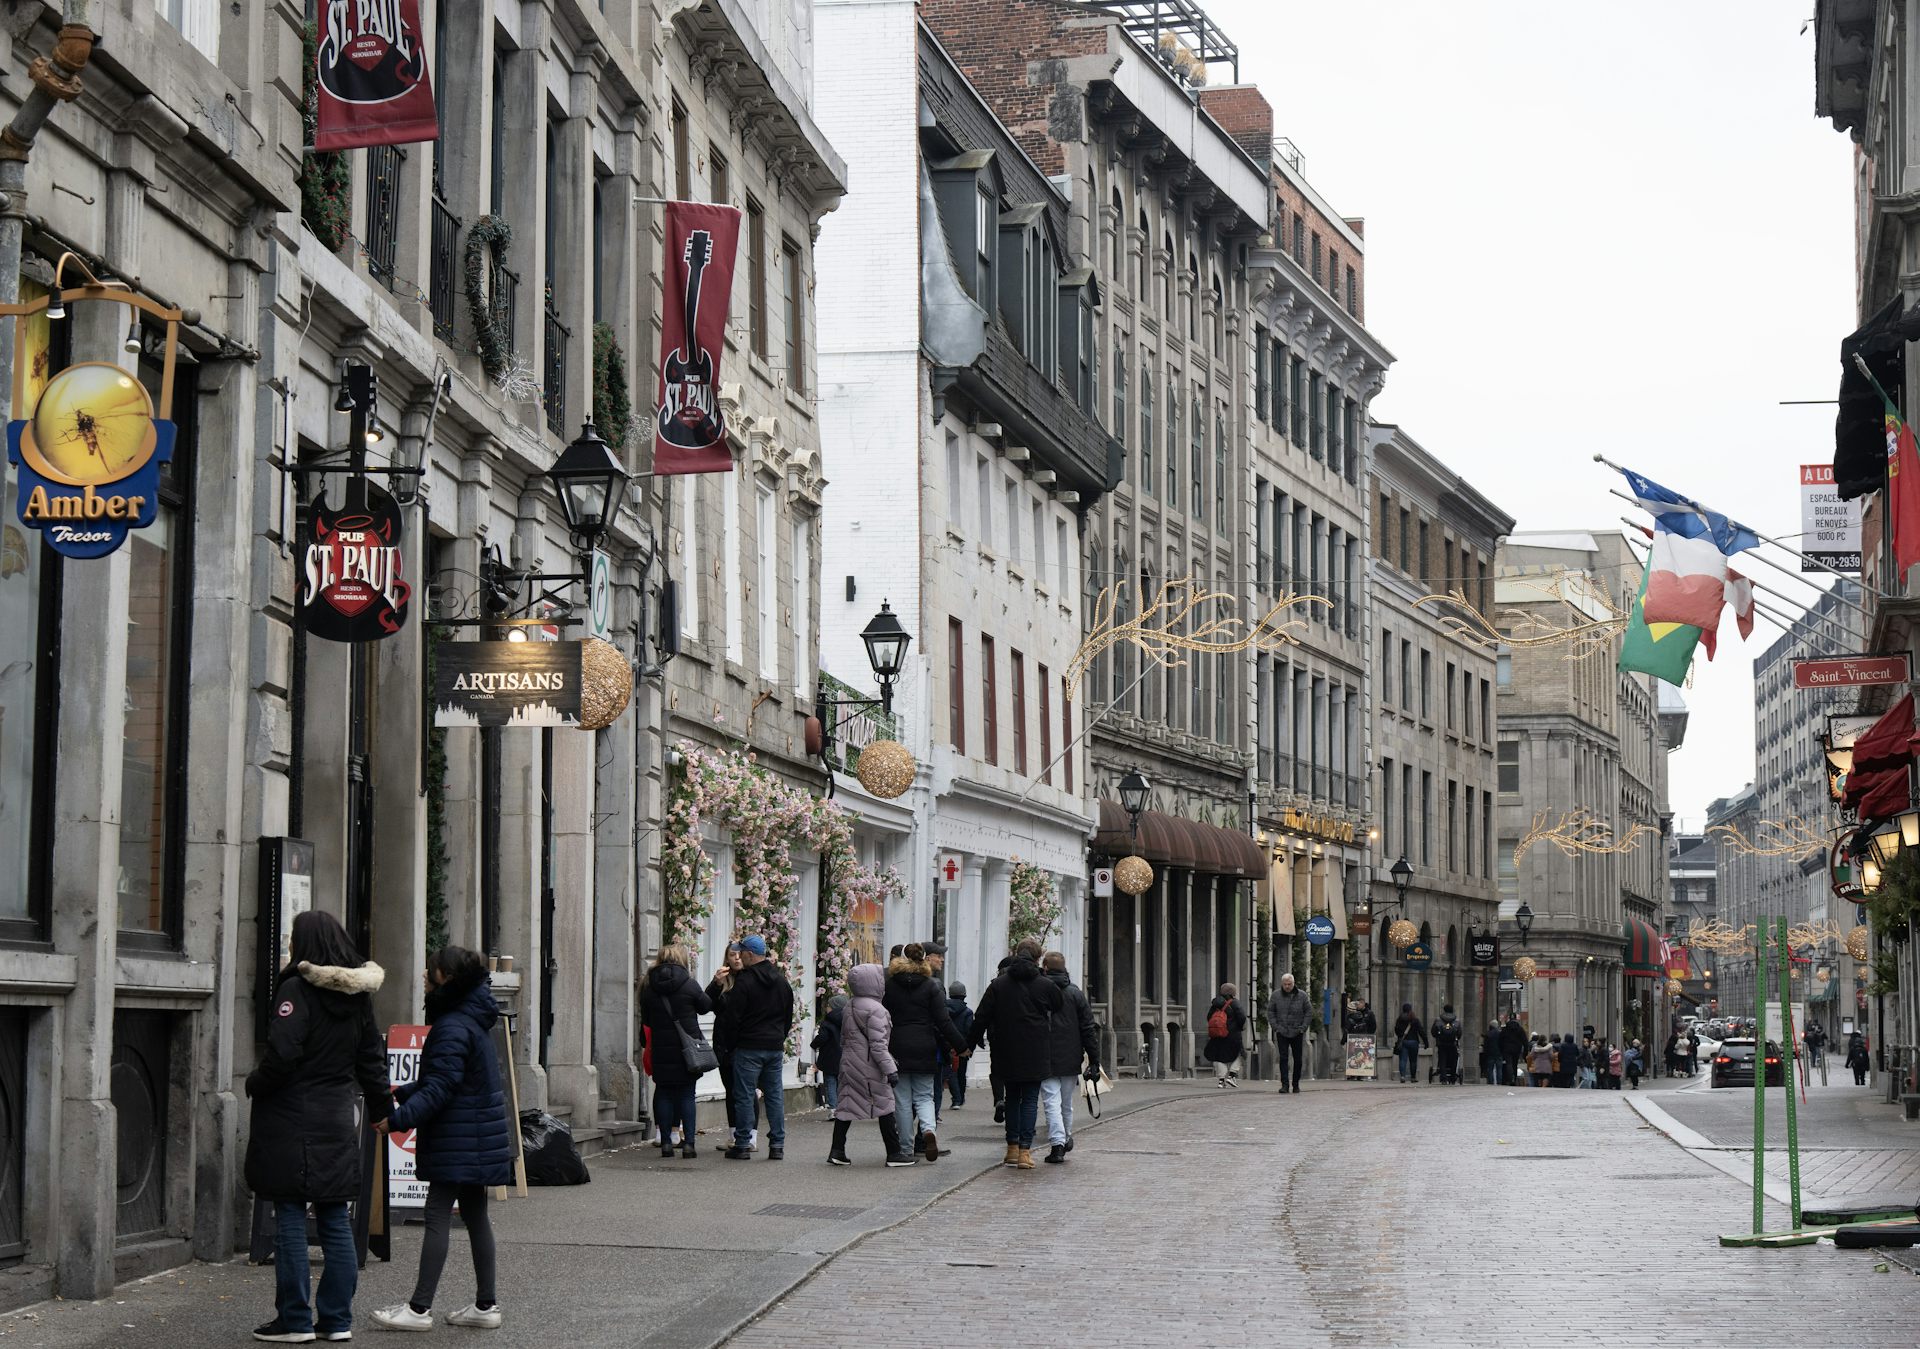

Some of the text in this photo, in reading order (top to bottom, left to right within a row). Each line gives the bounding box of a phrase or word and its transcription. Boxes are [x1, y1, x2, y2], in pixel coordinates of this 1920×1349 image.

[328, 0, 411, 69] ST. PAUL
[352, 50, 382, 58] SHOWBAR
[664, 382, 718, 427] ST. PAUL
[1804, 465, 1813, 481] À
[23, 485, 145, 520] Amber
[1814, 506, 1848, 515] BUREAUX
[1815, 517, 1847, 528] RÉNOVÉS
[51, 526, 112, 542] Tresor
[338, 532, 365, 542] PUB
[1817, 531, 1846, 541] 6000 PC
[1803, 556, 1860, 568] 51770-2939
[304, 543, 399, 613] ST. PAUL
[452, 672, 564, 694] ARTISANS
[1810, 668, 1892, 683] Saint-Vincent
